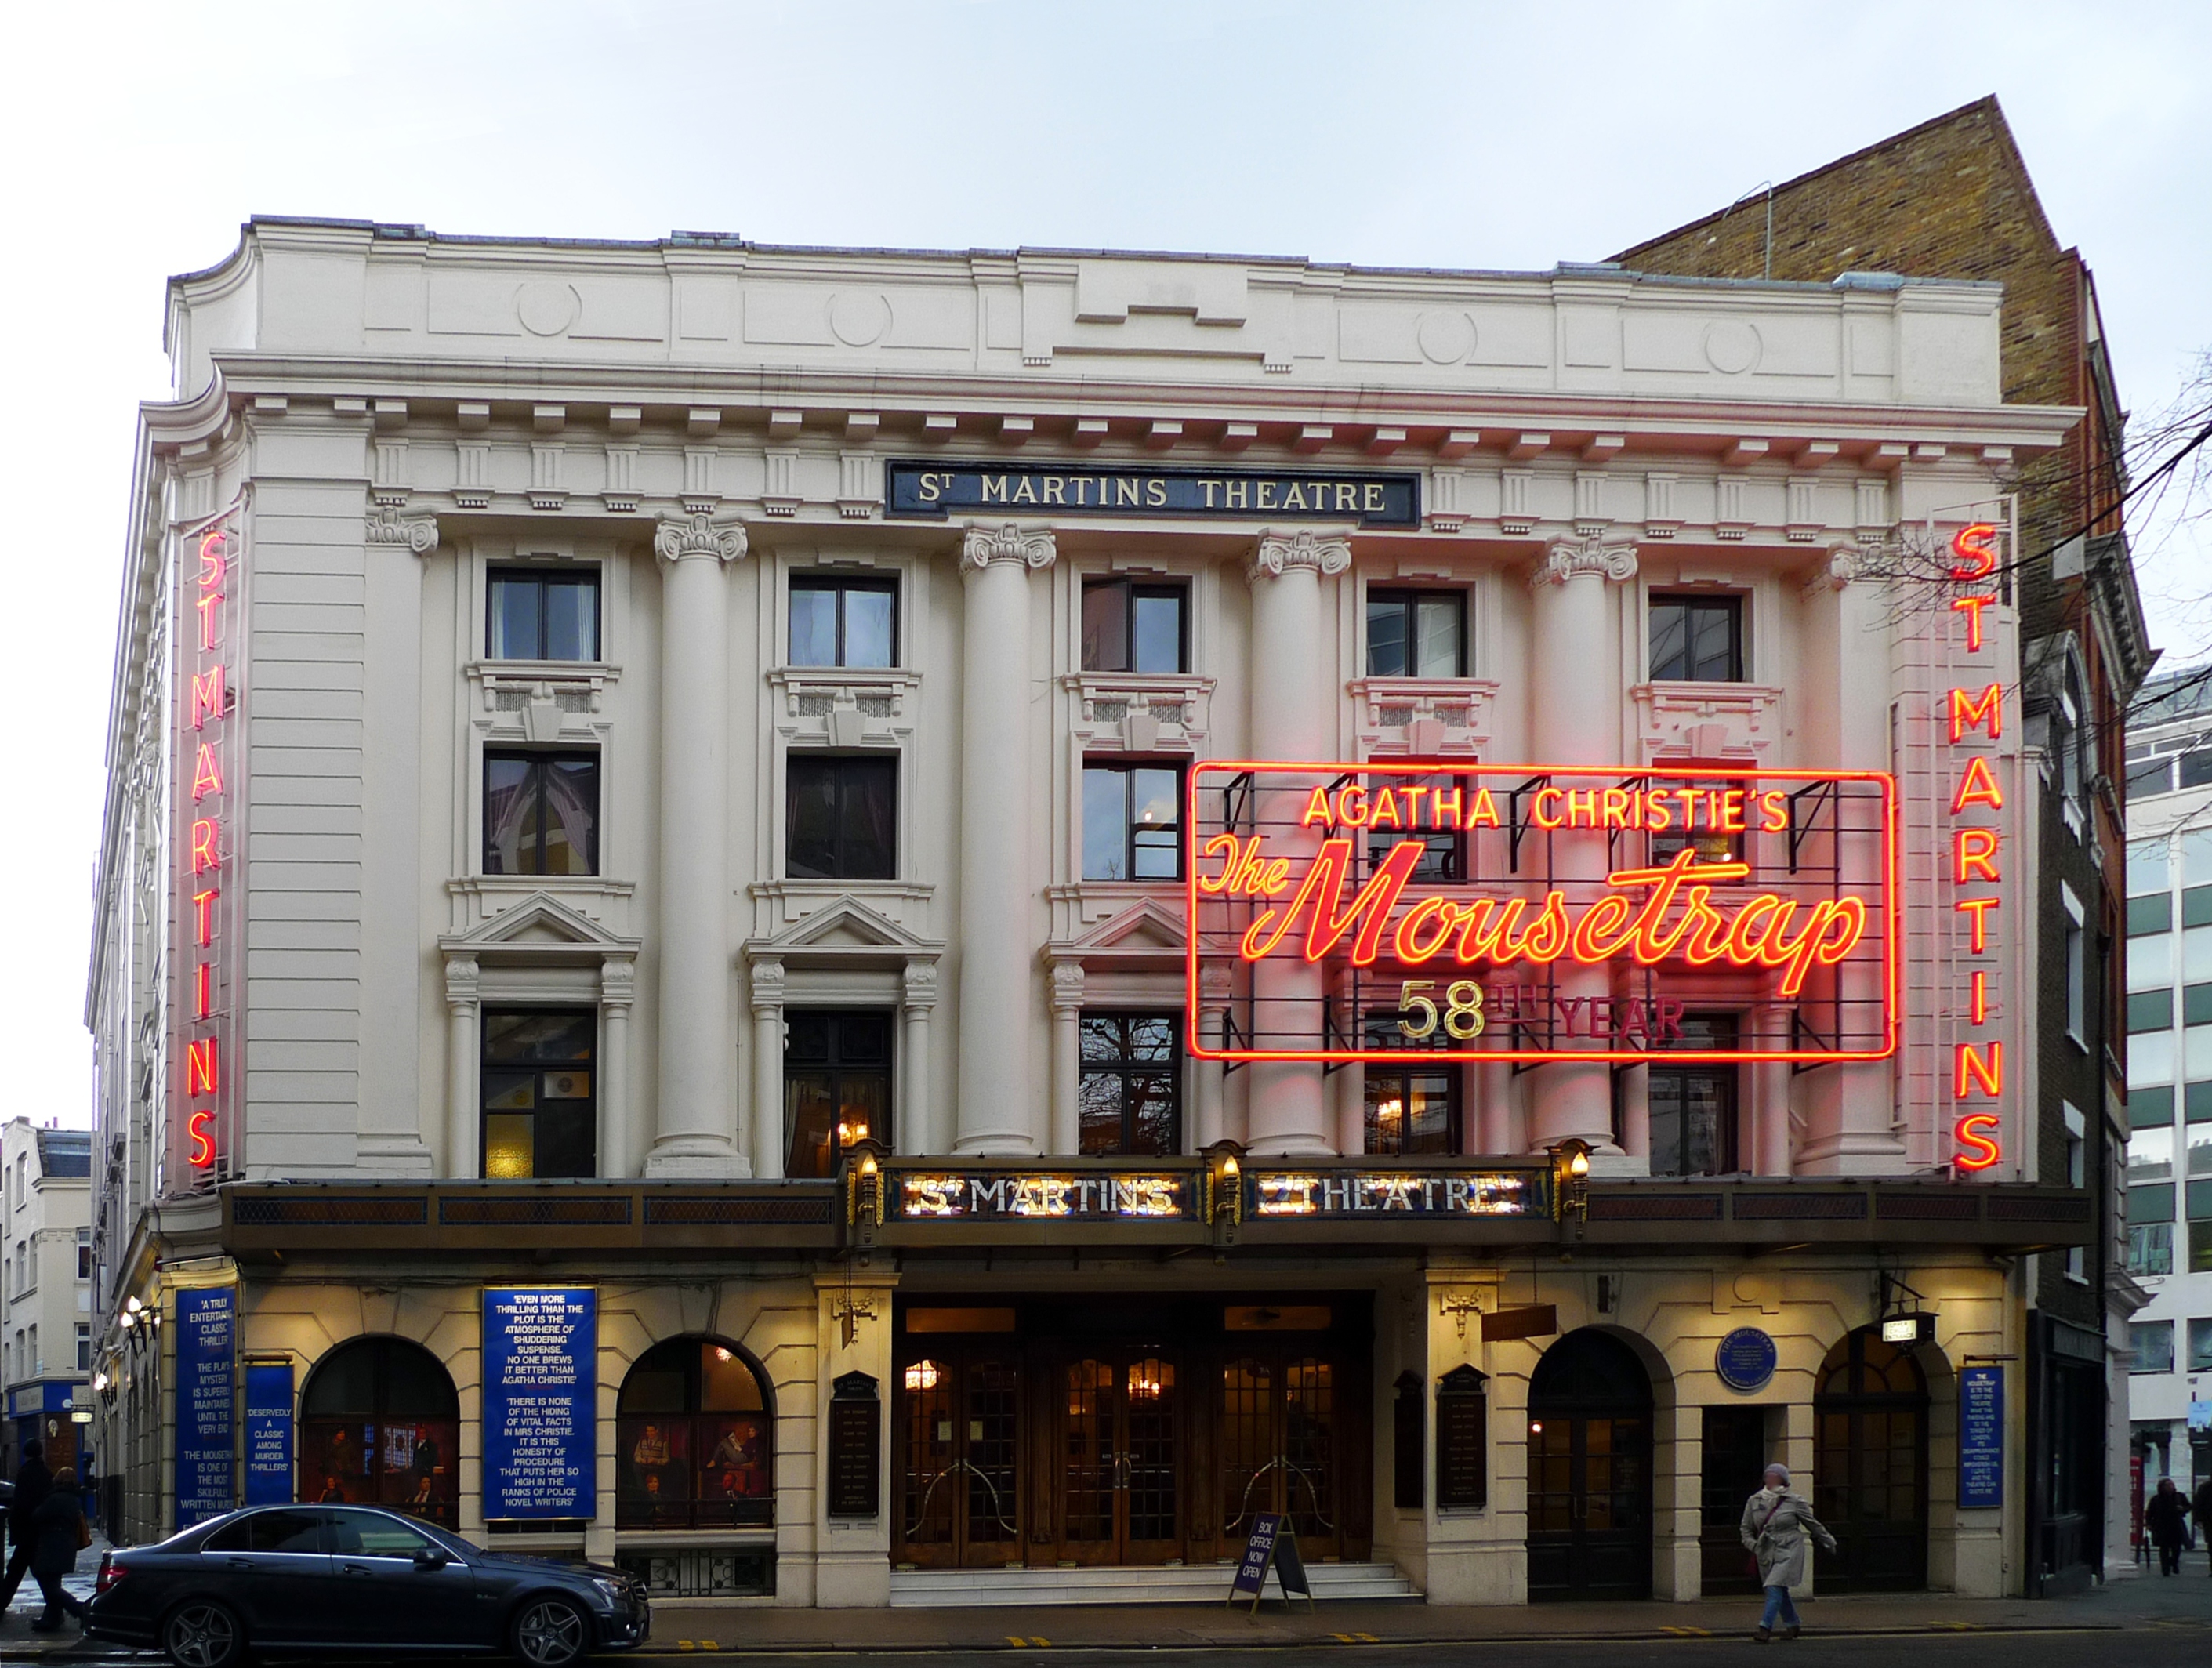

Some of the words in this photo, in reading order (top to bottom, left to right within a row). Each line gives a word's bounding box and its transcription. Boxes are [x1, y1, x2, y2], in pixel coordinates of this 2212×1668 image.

[919, 473, 955, 502] ST
[981, 474, 1168, 507] MARTINS
[1198, 479, 1386, 513] THEATRE
[1302, 786, 1500, 831] AGATHA
[1530, 787, 1790, 832] CHRISTIE'S
[1200, 834, 1290, 897] The
[1241, 839, 1867, 998] Mousetrap
[1556, 996, 1684, 1039] YEAR
[1294, 1178, 1499, 1211] THEATRE
[210, 1298, 228, 1309] TRULY
[513, 1294, 539, 1304] 'EVEN
[539, 1294, 566, 1304] MORE
[495, 1304, 539, 1314] THRILLING
[540, 1304, 565, 1314] THAN
[566, 1304, 584, 1314] THE
[513, 1314, 536, 1325] PLOT
[537, 1314, 546, 1324] IS
[547, 1314, 564, 1324] THE
[201, 1322, 228, 1334] CLASSIC
[504, 1325, 560, 1334] ATMOSPHERE
[562, 1325, 575, 1334] OF
[199, 1335, 228, 1347] THRILLER
[513, 1335, 568, 1344] SHUDDERING
[1721, 1338, 1734, 1354] THE
[1733, 1329, 1774, 1354] MOUSETRAP
[517, 1345, 563, 1354] SUSPENSE.
[507, 1355, 520, 1365] NO
[521, 1355, 541, 1365] ONE
[542, 1355, 573, 1365] BREWS
[197, 1362, 212, 1372] THE
[504, 1365, 513, 1375] IT
[514, 1365, 549, 1375] BETTER
[549, 1365, 575, 1374] THAN
[199, 1373, 228, 1385] MYSTERY
[502, 1376, 536, 1385] AGATHA
[537, 1375, 577, 1384] CHRISTIE'
[193, 1387, 201, 1398] IS
[506, 1397, 536, 1406] 'THERE
[538, 1397, 547, 1406] IS
[548, 1397, 572, 1406] NONE
[198, 1412, 218, 1422] UNTIL
[219, 1411, 229, 1421] THE
[247, 1409, 292, 1417] 'DESERVEDLY
[508, 1407, 520, 1416] OF
[522, 1407, 539, 1416] THE
[541, 1407, 570, 1416] HIDING
[266, 1420, 273, 1428] A
[506, 1417, 519, 1427] OF
[520, 1417, 544, 1427] VITAL
[545, 1417, 572, 1426] FACTS
[198, 1424, 217, 1434] VERY
[217, 1423, 229, 1434] END
[503, 1427, 513, 1437] IN
[514, 1427, 533, 1437] MRS
[535, 1427, 575, 1436] CHRISTIE.
[254, 1430, 285, 1439] CLASSIC
[256, 1441, 282, 1450] AMONG
[520, 1438, 528, 1446] IT
[529, 1438, 538, 1446] IS
[539, 1438, 560, 1446] THIS
[183, 1450, 201, 1460] THE
[254, 1452, 284, 1461] MURDER
[512, 1447, 553, 1456] HONESTY
[554, 1447, 567, 1456] OF
[198, 1463, 205, 1472] IS
[207, 1462, 221, 1472] ONE
[221, 1462, 229, 1472] OF
[513, 1457, 565, 1467] PROCEDURE
[250, 1463, 288, 1472] THRILLERS'
[499, 1467, 521, 1477] THAT
[522, 1467, 546, 1476] PUTS
[546, 1467, 565, 1476] HER
[566, 1467, 579, 1477] SO
[197, 1475, 212, 1485] THE
[213, 1474, 229, 1485] MOST
[514, 1478, 535, 1487] HIGH
[536, 1478, 546, 1486] IN
[547, 1478, 564, 1486] THE
[502, 1488, 531, 1497] RANKS
[532, 1487, 545, 1496] OF
[546, 1487, 577, 1496] POLICE
[180, 1499, 216, 1509] WRITTEN
[505, 1497, 533, 1507] NOVEL
[535, 1497, 575, 1507] WRITERS'
[1259, 1522, 1273, 1534] BOX
[1250, 1536, 1273, 1549] OFFICE
[1249, 1551, 1265, 1563] NOW
[1242, 1565, 1261, 1578] OPEN
